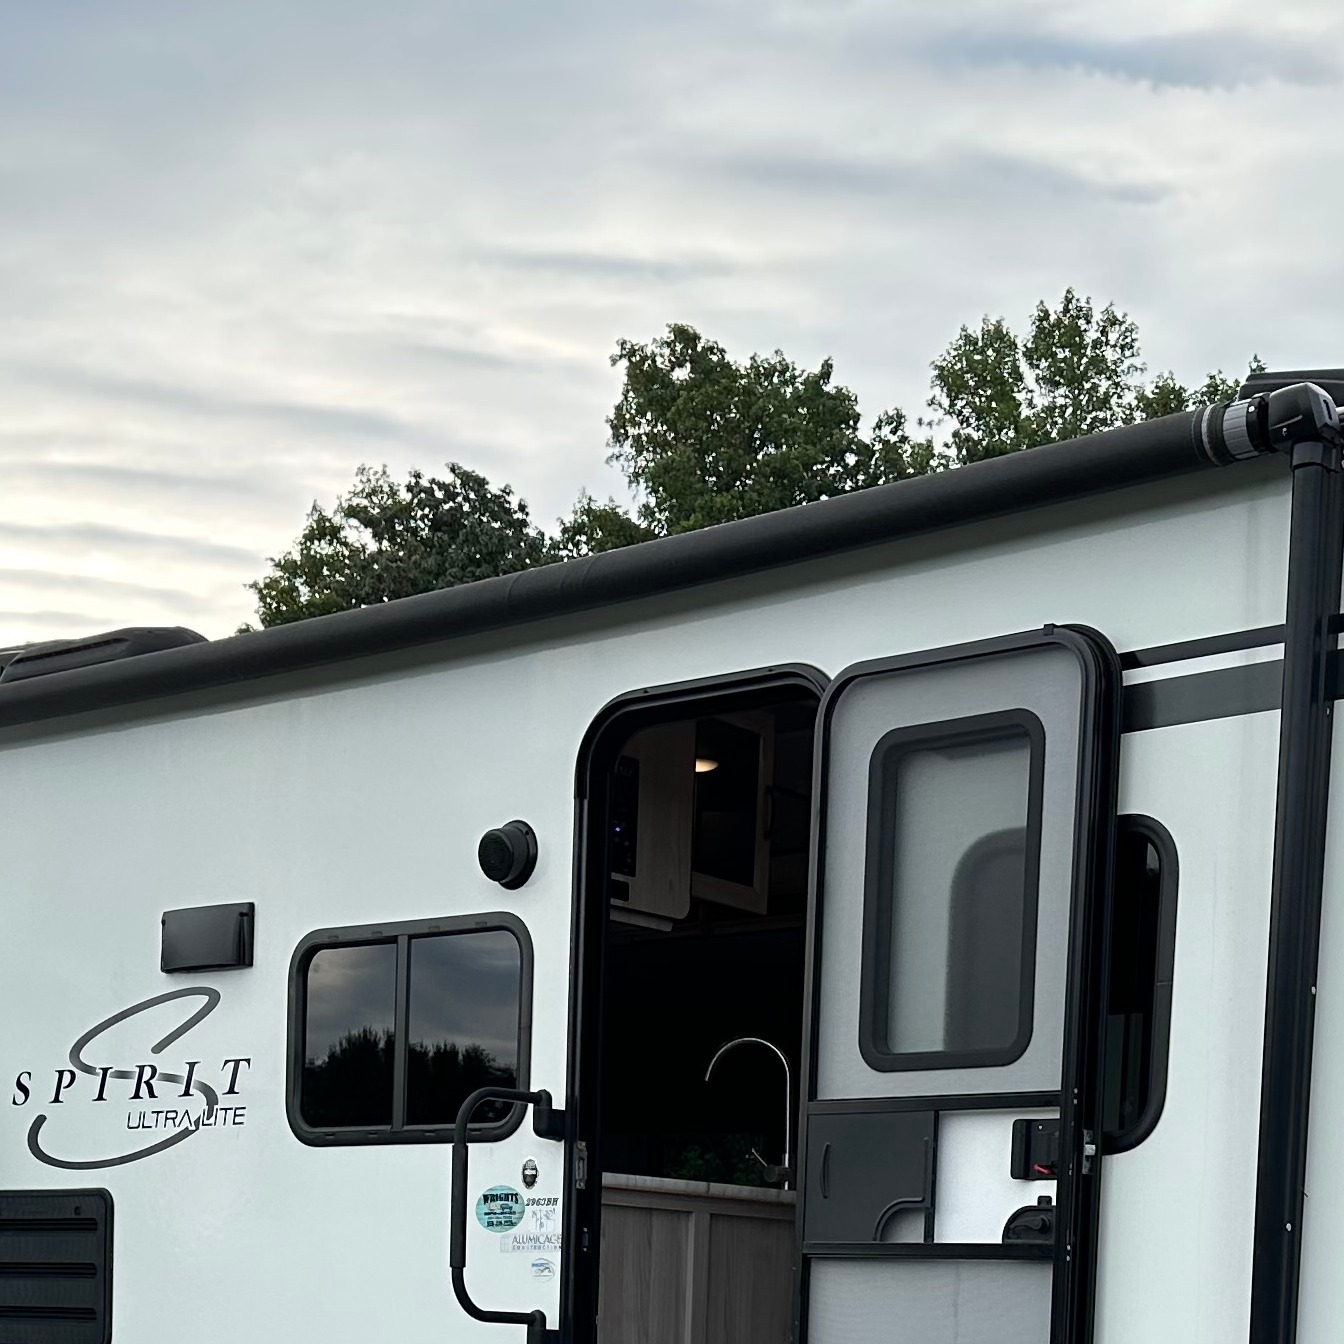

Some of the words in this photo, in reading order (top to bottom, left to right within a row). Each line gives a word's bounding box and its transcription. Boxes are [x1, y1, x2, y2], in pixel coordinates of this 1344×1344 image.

[11, 1058, 251, 1106] SPIRIT
[127, 1109, 193, 1129] ULTRA
[201, 1106, 247, 1127] LITE
